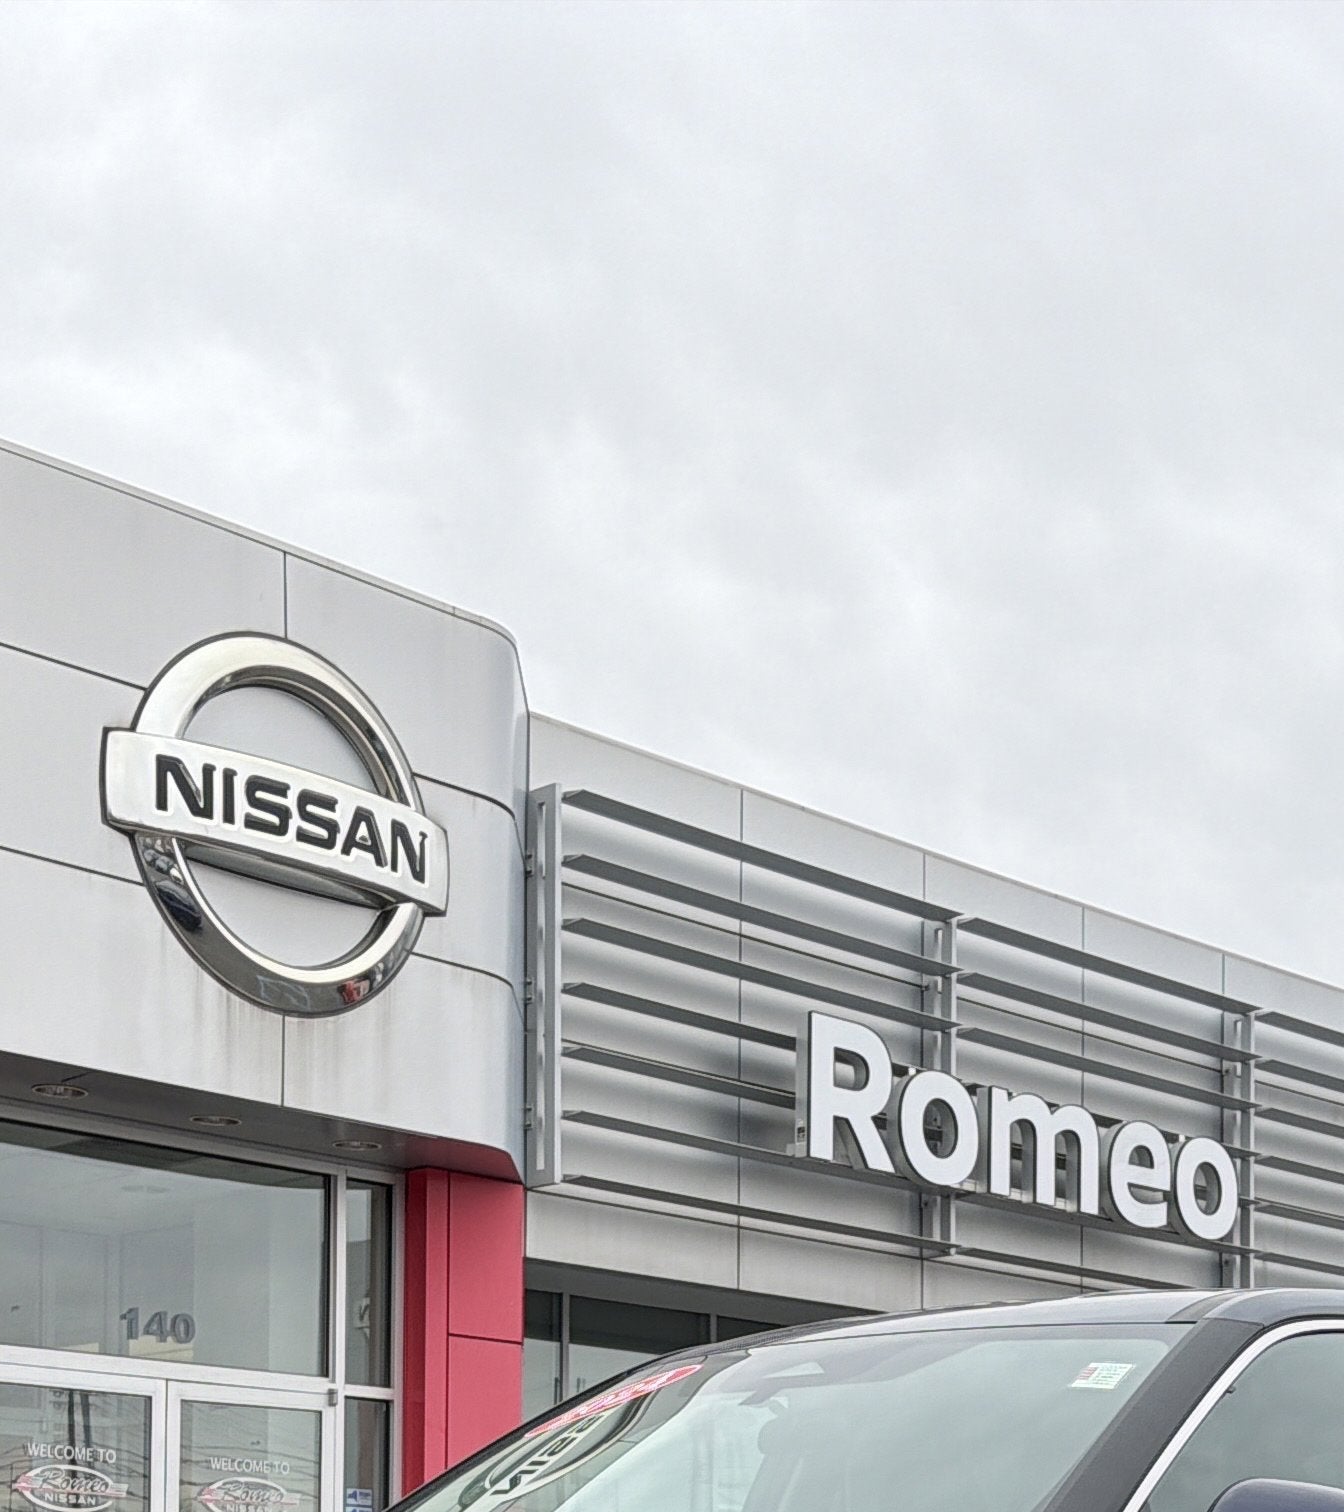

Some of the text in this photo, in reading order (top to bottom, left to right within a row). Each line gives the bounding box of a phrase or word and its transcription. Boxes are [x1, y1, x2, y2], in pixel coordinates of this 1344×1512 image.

[155, 753, 428, 884] NISSAN
[802, 1010, 1239, 1241] Romeo
[119, 1307, 196, 1344] 140
[26, 1443, 117, 1464] WELCOME TO
[209, 1457, 291, 1475] WELCOME TO
[37, 1467, 111, 1493] Romeo
[44, 1494, 96, 1506] NISSAN
